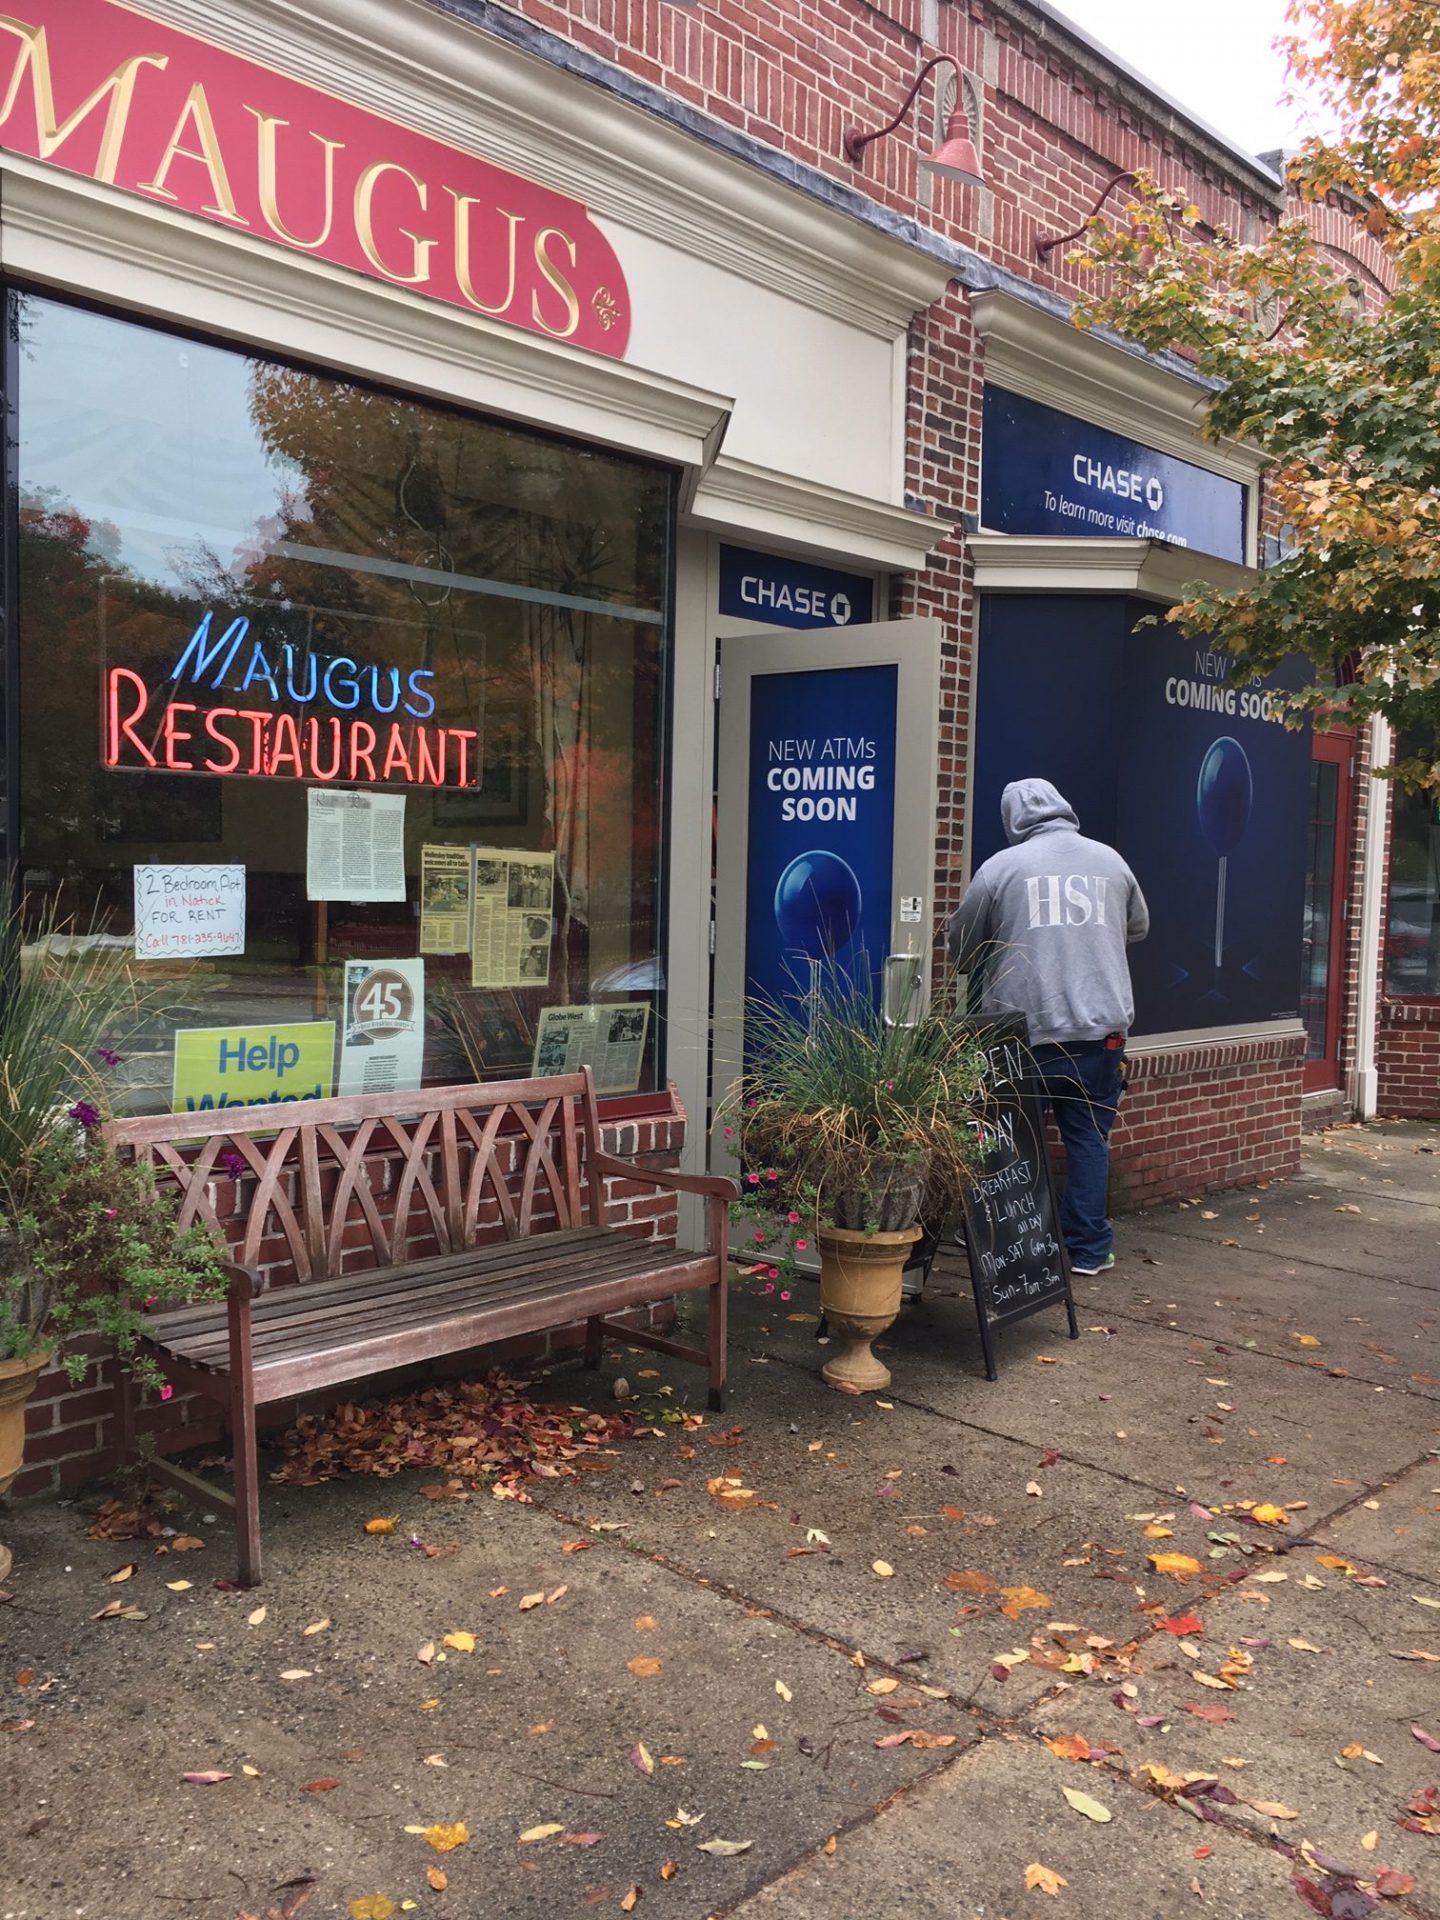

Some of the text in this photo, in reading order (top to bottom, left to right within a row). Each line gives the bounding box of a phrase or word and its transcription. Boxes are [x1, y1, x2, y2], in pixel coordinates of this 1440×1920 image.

[0, 14, 579, 337] MAUGUS
[1073, 454, 1143, 503] CHASE
[1044, 490, 1057, 511] To
[1059, 494, 1085, 521] learn
[1087, 508, 1114, 529] more
[1116, 515, 1136, 536] visit
[740, 575, 826, 618] CHASE
[170, 610, 437, 719] MAUGUS
[1195, 650, 1227, 680] NEW
[1165, 677, 1236, 715] COMING
[105, 667, 479, 788] RESTAURANT
[768, 737, 876, 761] NEW ATMs
[767, 766, 875, 792] COMING
[782, 797, 857, 821] SOON
[145, 874, 161, 895] 2
[162, 873, 219, 893] Bedroom
[165, 894, 226, 907] in Natick
[151, 908, 227, 923] FOR RENT
[145, 933, 170, 949] Call
[360, 982, 402, 1020] 45
[548, 1012, 583, 1021] Globe West
[219, 1036, 300, 1078] Help
